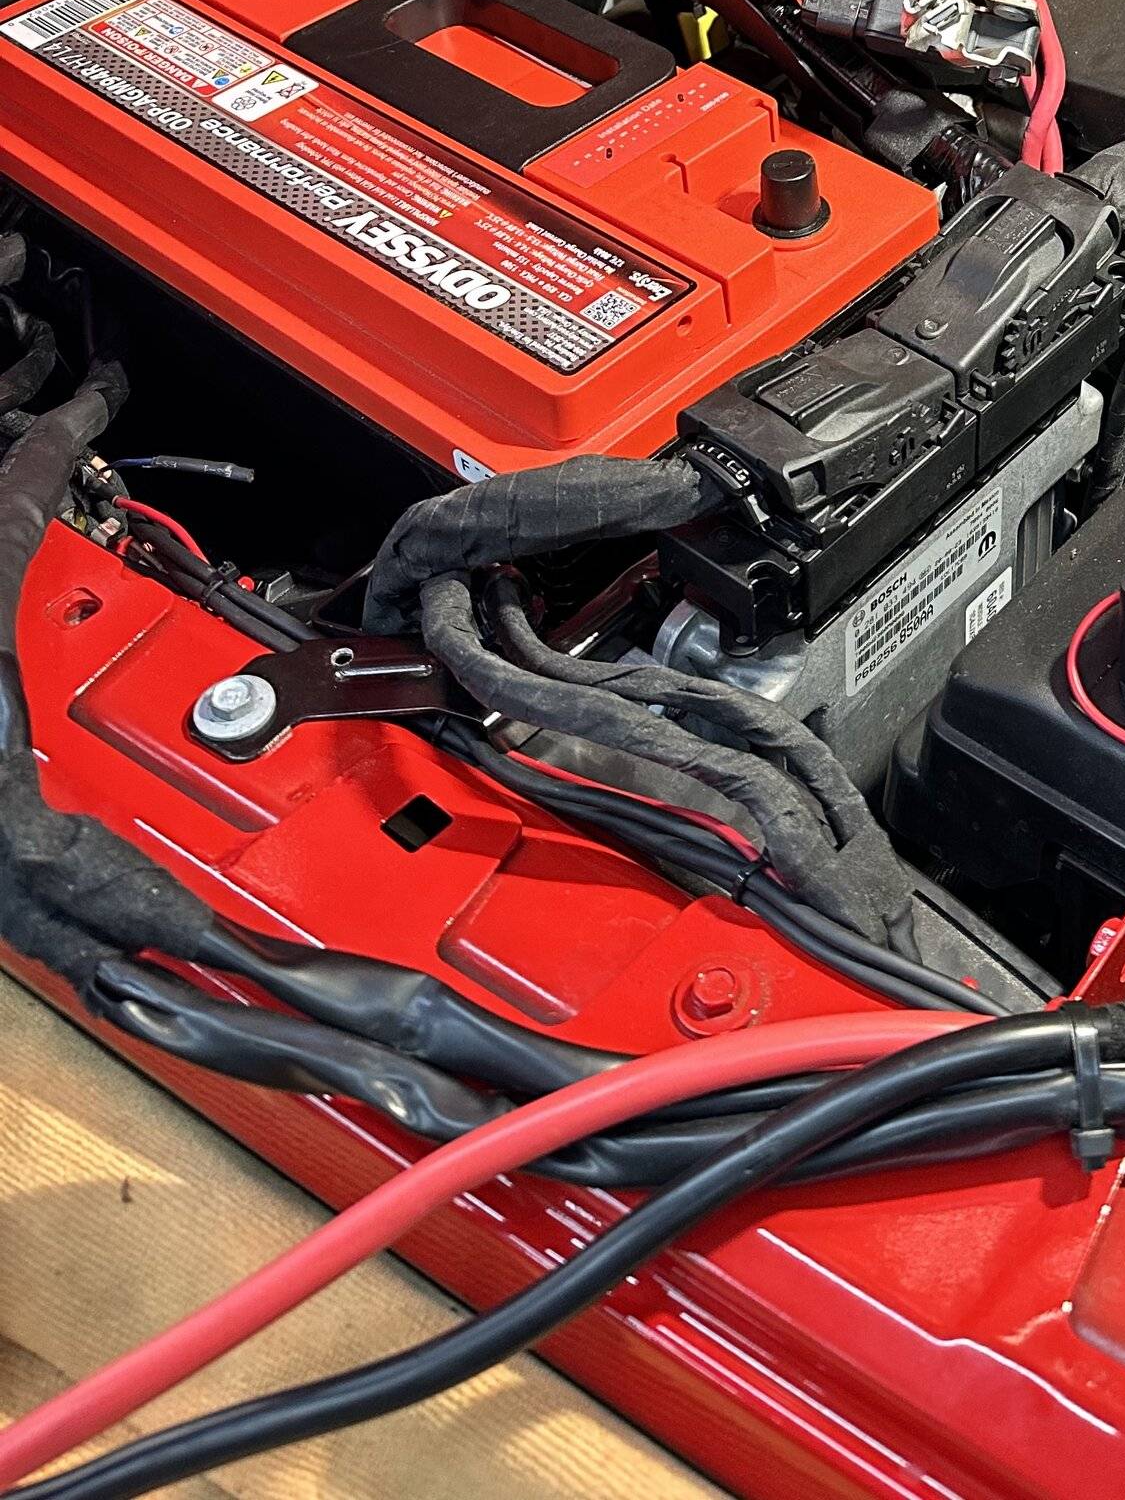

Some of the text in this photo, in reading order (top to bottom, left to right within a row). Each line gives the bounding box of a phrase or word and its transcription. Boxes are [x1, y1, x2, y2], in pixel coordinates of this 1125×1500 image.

[42, 41, 72, 57] L4
[58, 53, 92, 69] H7
[100, 27, 194, 82] DANGER/POISON
[79, 63, 193, 130] ODP-AGM94R
[199, 118, 510, 309] ODYSSEY Performance
[870, 572, 907, 611] BOSCH
[854, 640, 897, 685] P68256
[899, 604, 933, 643] 850AA
